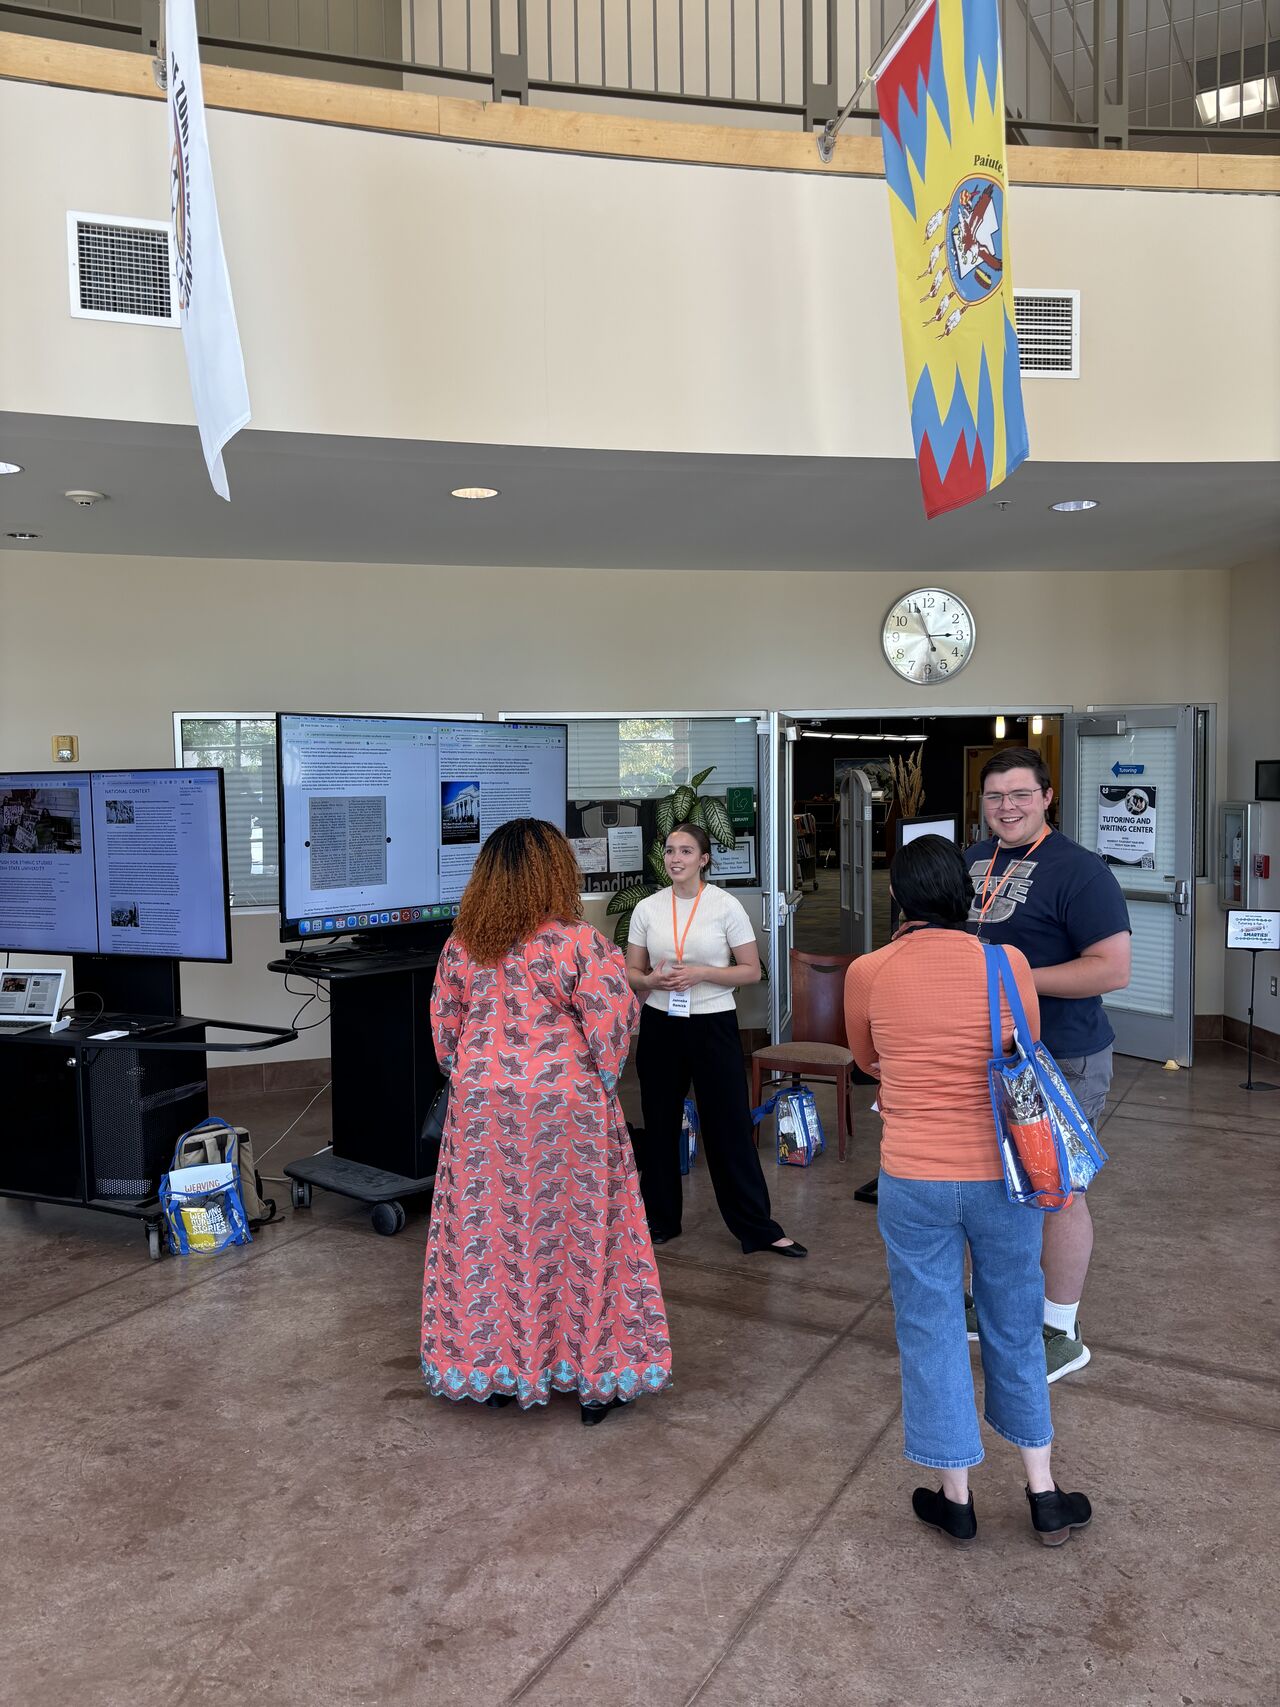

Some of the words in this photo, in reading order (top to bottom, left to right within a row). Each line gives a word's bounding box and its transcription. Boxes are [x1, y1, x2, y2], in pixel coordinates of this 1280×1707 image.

[175, 79, 189, 148] ZUNI
[974, 154, 1003, 173] Paiute
[908, 602, 918, 613] 11
[922, 598, 935, 608] 12
[942, 602, 946, 612] 1
[896, 616, 908, 626] 10
[952, 614, 960, 624] 2
[892, 632, 900, 642] 9
[956, 630, 964, 640] 3
[896, 648, 904, 659] 8
[952, 647, 958, 656] 4
[909, 660, 916, 670] 7
[924, 664, 931, 674] 6
[940, 660, 948, 670] 5
[184, 1179, 220, 1193] WEAVING
[189, 1204, 222, 1219] WEAVING
[192, 1218, 207, 1226] OUR
[192, 1222, 226, 1232] STORIES
